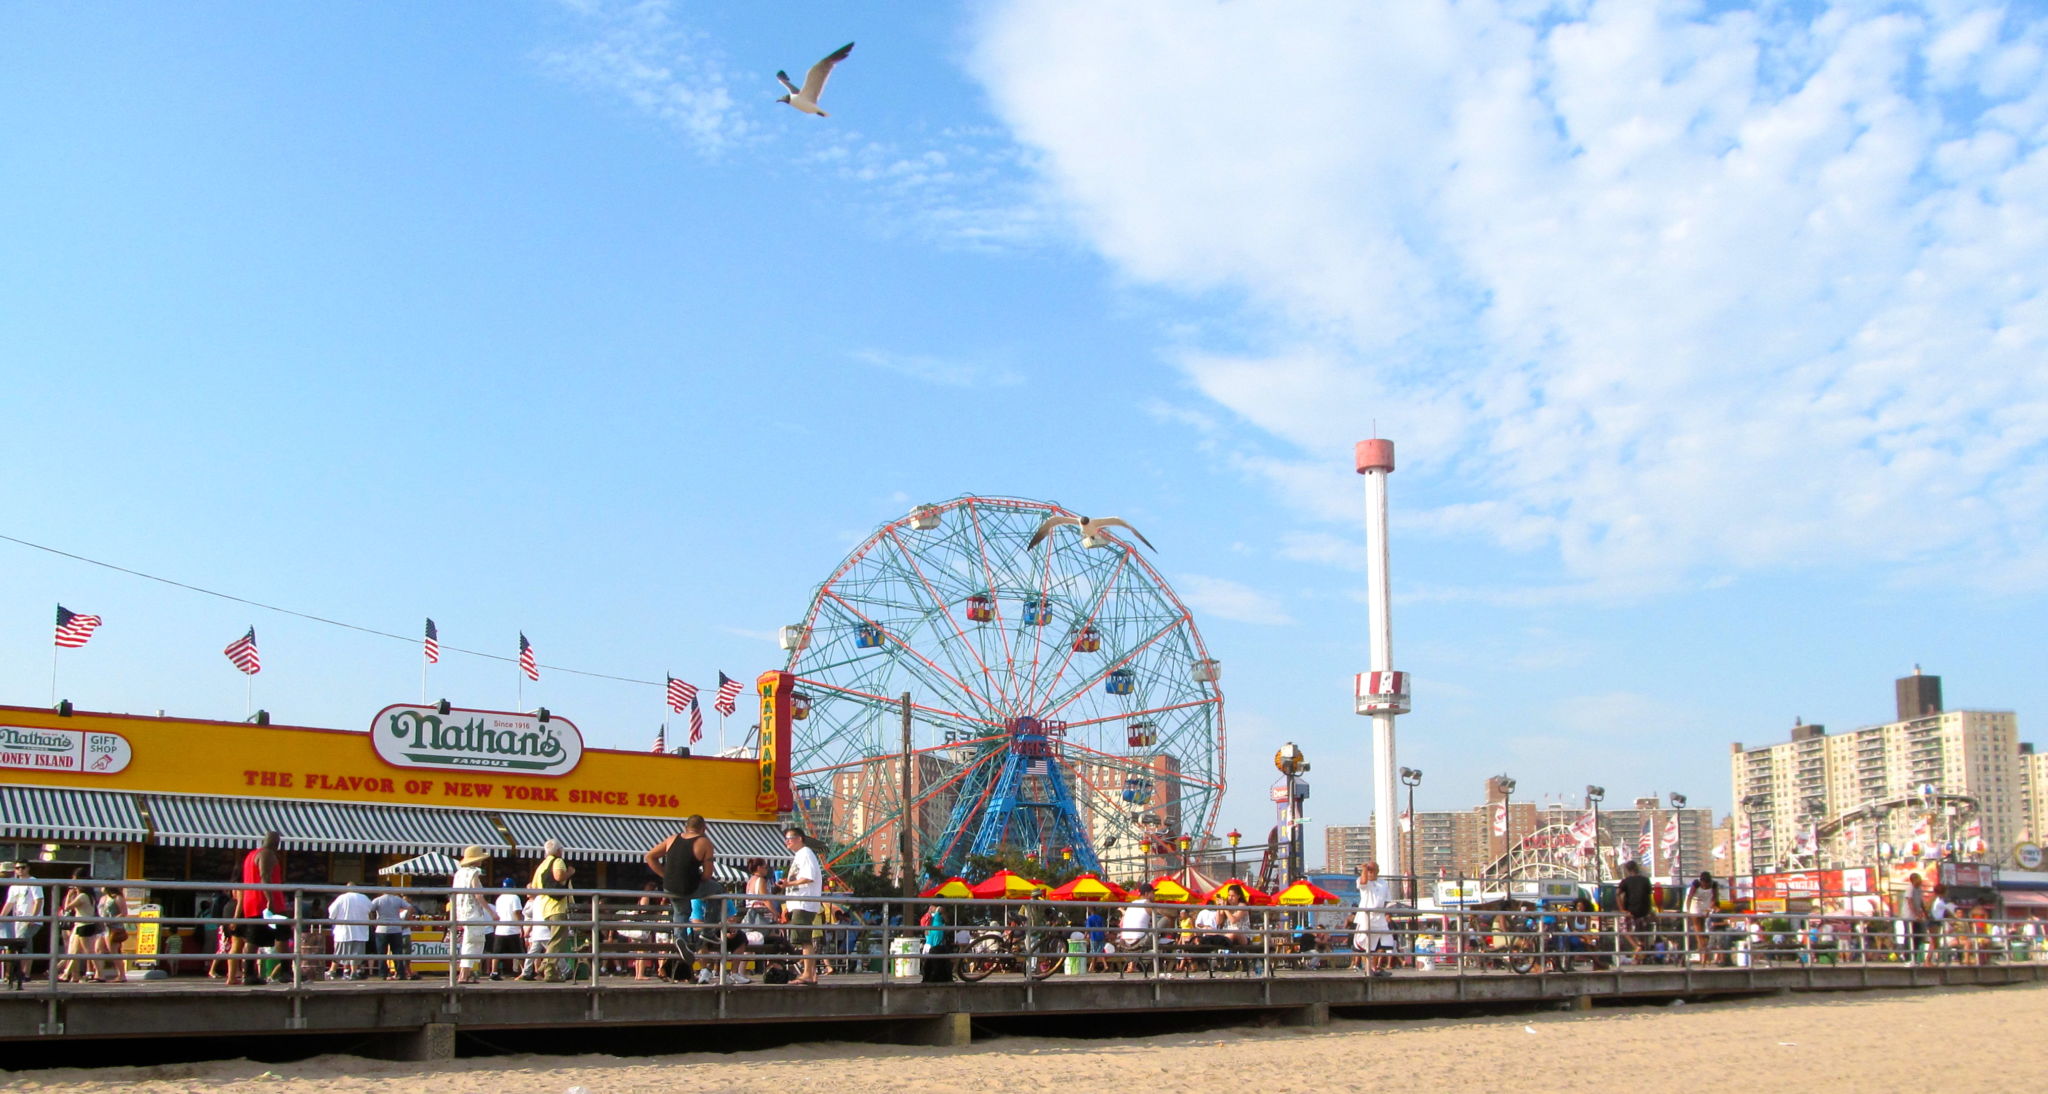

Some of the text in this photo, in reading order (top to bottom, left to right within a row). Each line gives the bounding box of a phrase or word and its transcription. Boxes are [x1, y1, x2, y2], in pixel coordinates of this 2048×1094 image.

[493, 719, 531, 729] Since 1916
[0, 728, 72, 748] Nathan's
[90, 735, 118, 745] GIFT
[390, 710, 561, 758] Nathan's
[762, 684, 773, 793] NATHANS
[90, 744, 118, 754] SHOP
[35, 754, 74, 768] ISLAND
[452, 757, 509, 767] FAMOUS
[243, 770, 680, 808] THE FLAVOR OF NEW YORK SINCE 1916
